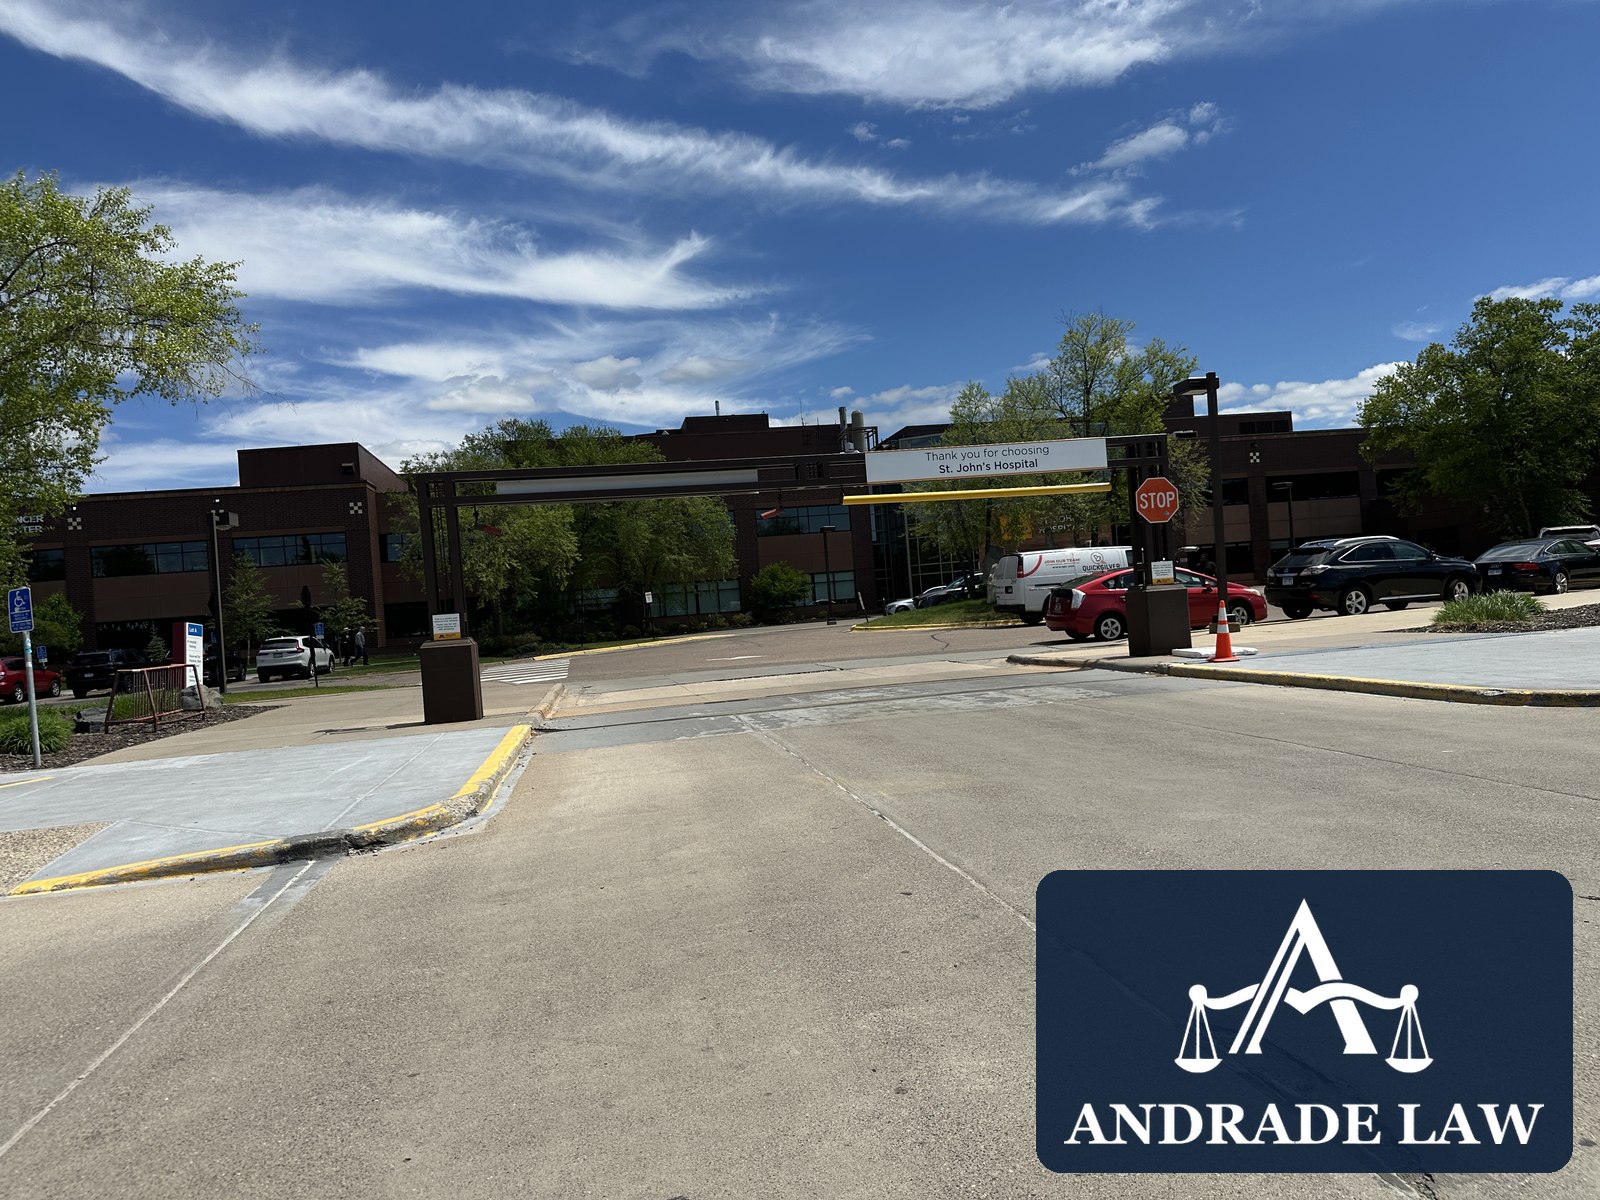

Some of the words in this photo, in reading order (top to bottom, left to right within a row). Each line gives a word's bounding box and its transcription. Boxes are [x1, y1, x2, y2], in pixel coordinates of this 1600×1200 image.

[925, 450, 958, 461] Thank
[961, 450, 980, 460] you
[983, 448, 998, 458] for
[1001, 446, 1050, 455] choosing
[938, 464, 953, 473] St.
[956, 462, 991, 473] John's
[994, 458, 1038, 470] Hospital
[1139, 491, 1175, 509] STOP
